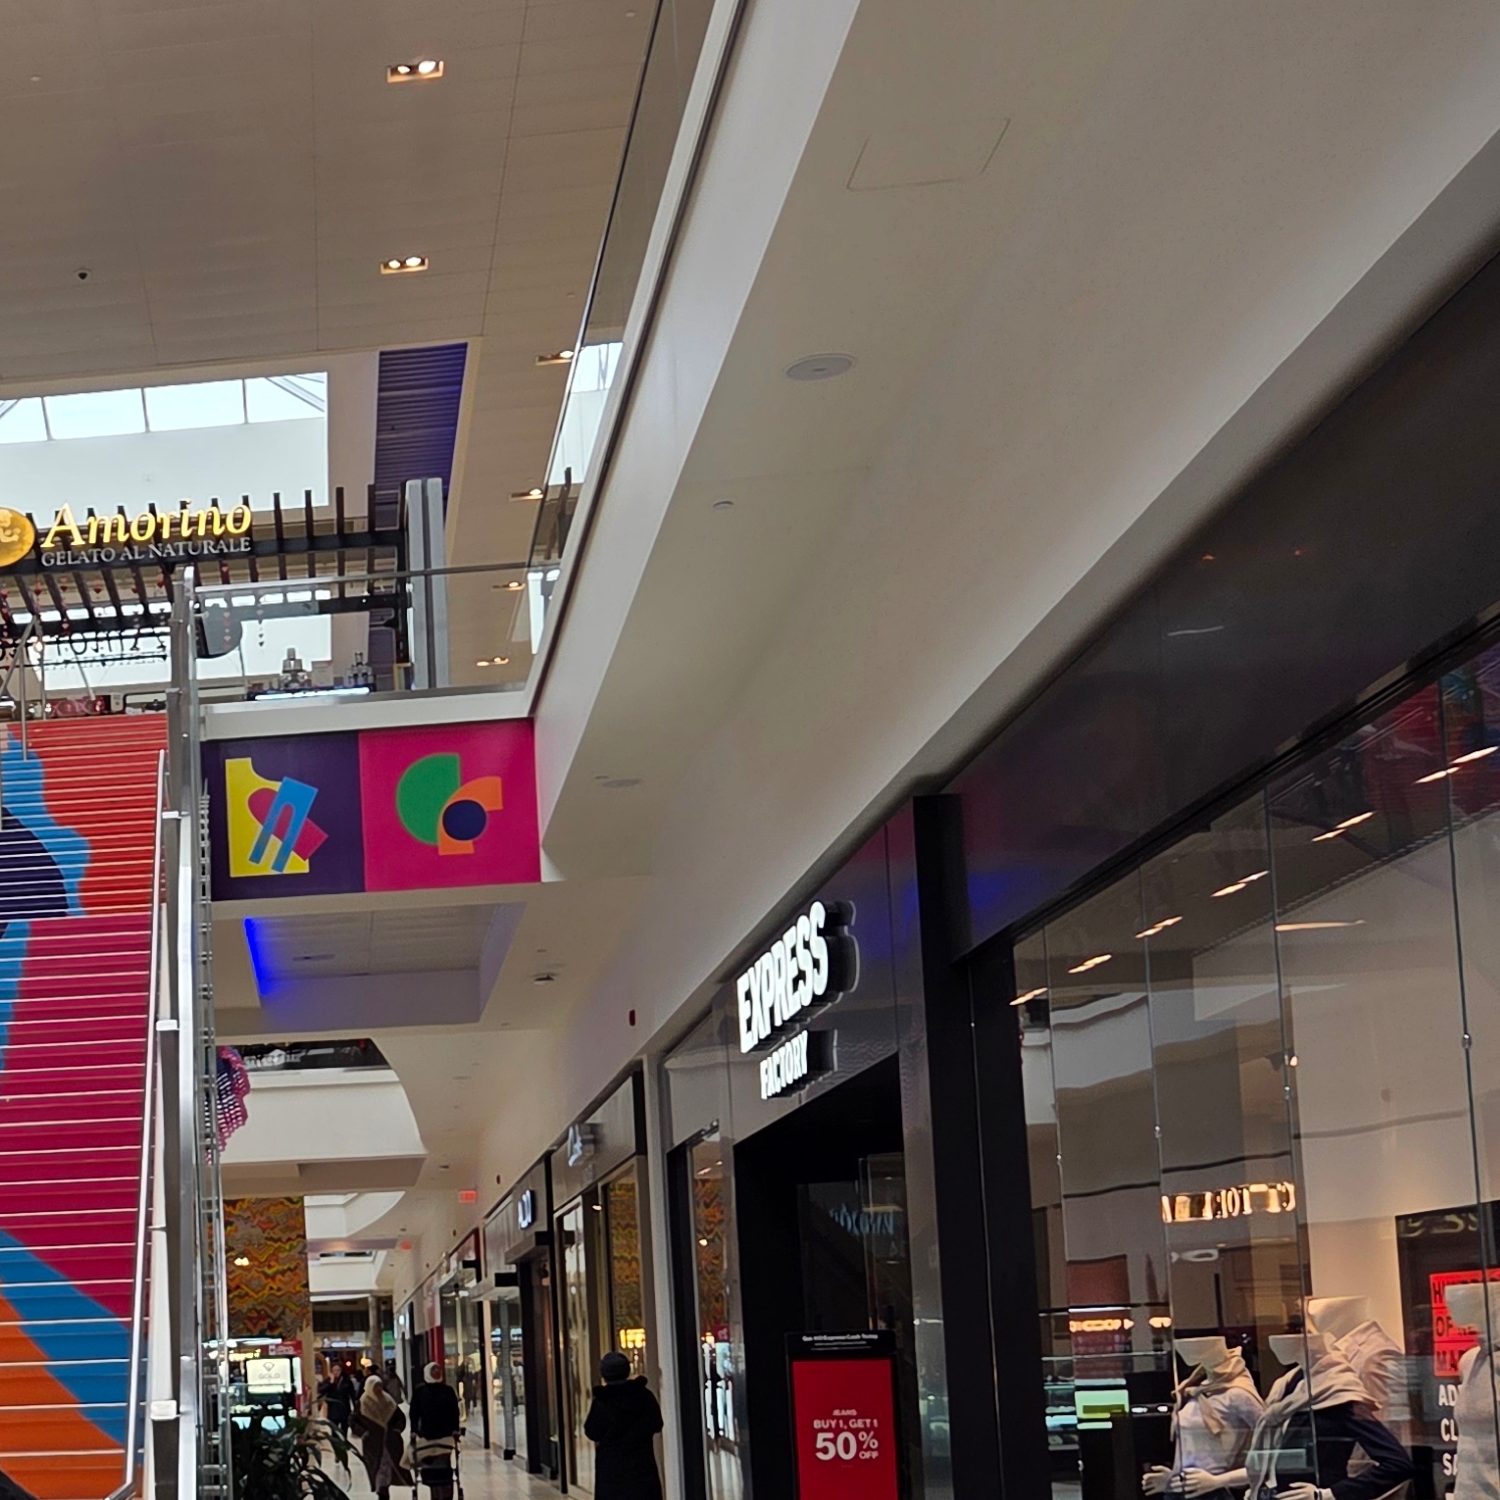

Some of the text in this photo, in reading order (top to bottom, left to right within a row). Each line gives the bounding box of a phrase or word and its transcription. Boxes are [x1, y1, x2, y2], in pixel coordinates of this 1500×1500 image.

[40, 499, 252, 548] Amorino
[41, 537, 252, 567] GELATO AL NATURALE
[736, 901, 829, 1054] EXPRESS
[760, 1030, 809, 1100] FACTORY
[813, 1420, 838, 1429] BUY
[848, 1419, 871, 1428] GET
[873, 1419, 878, 1428] 1
[859, 1450, 879, 1460] OFF
